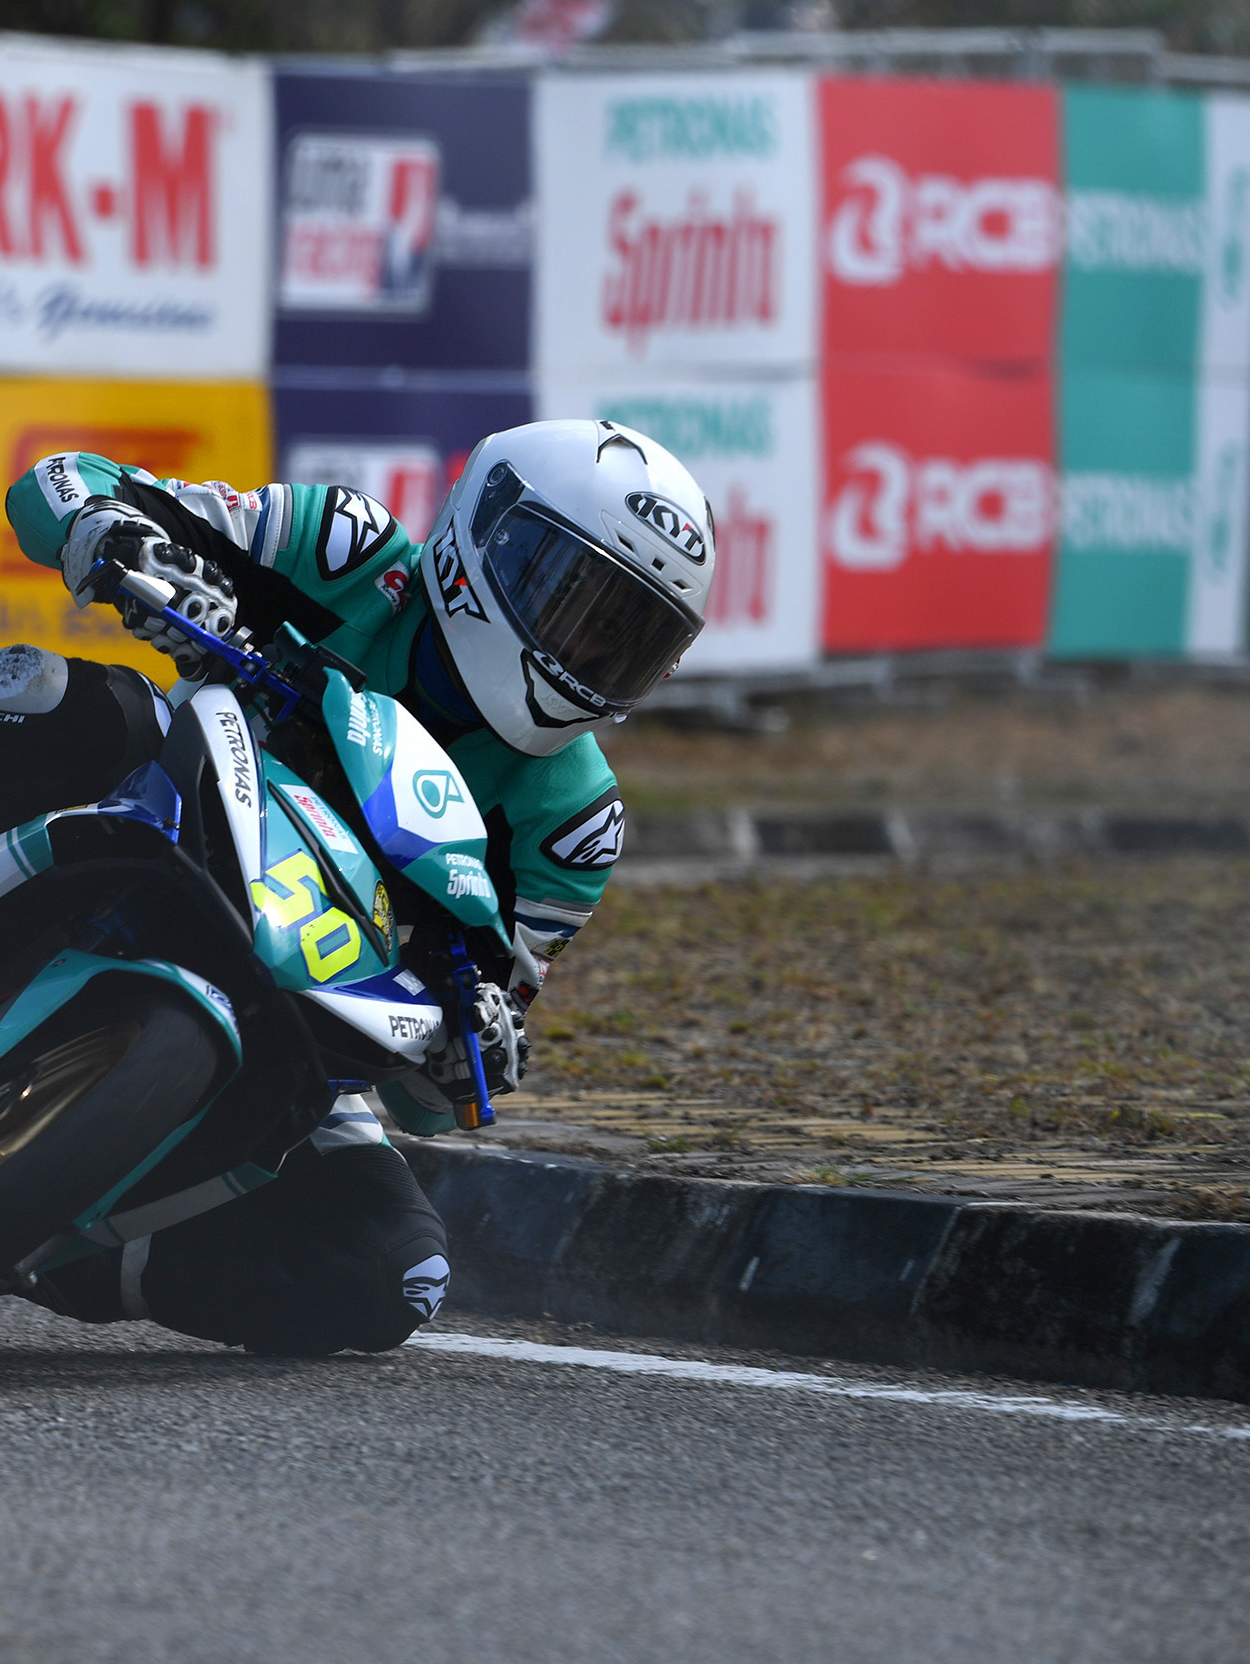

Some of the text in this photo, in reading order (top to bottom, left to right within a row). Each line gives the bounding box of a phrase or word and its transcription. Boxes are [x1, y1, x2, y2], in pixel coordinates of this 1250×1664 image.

[635, 494, 704, 552] KYT
[215, 711, 252, 808] PETRONAS
[250, 849, 362, 984] 50
